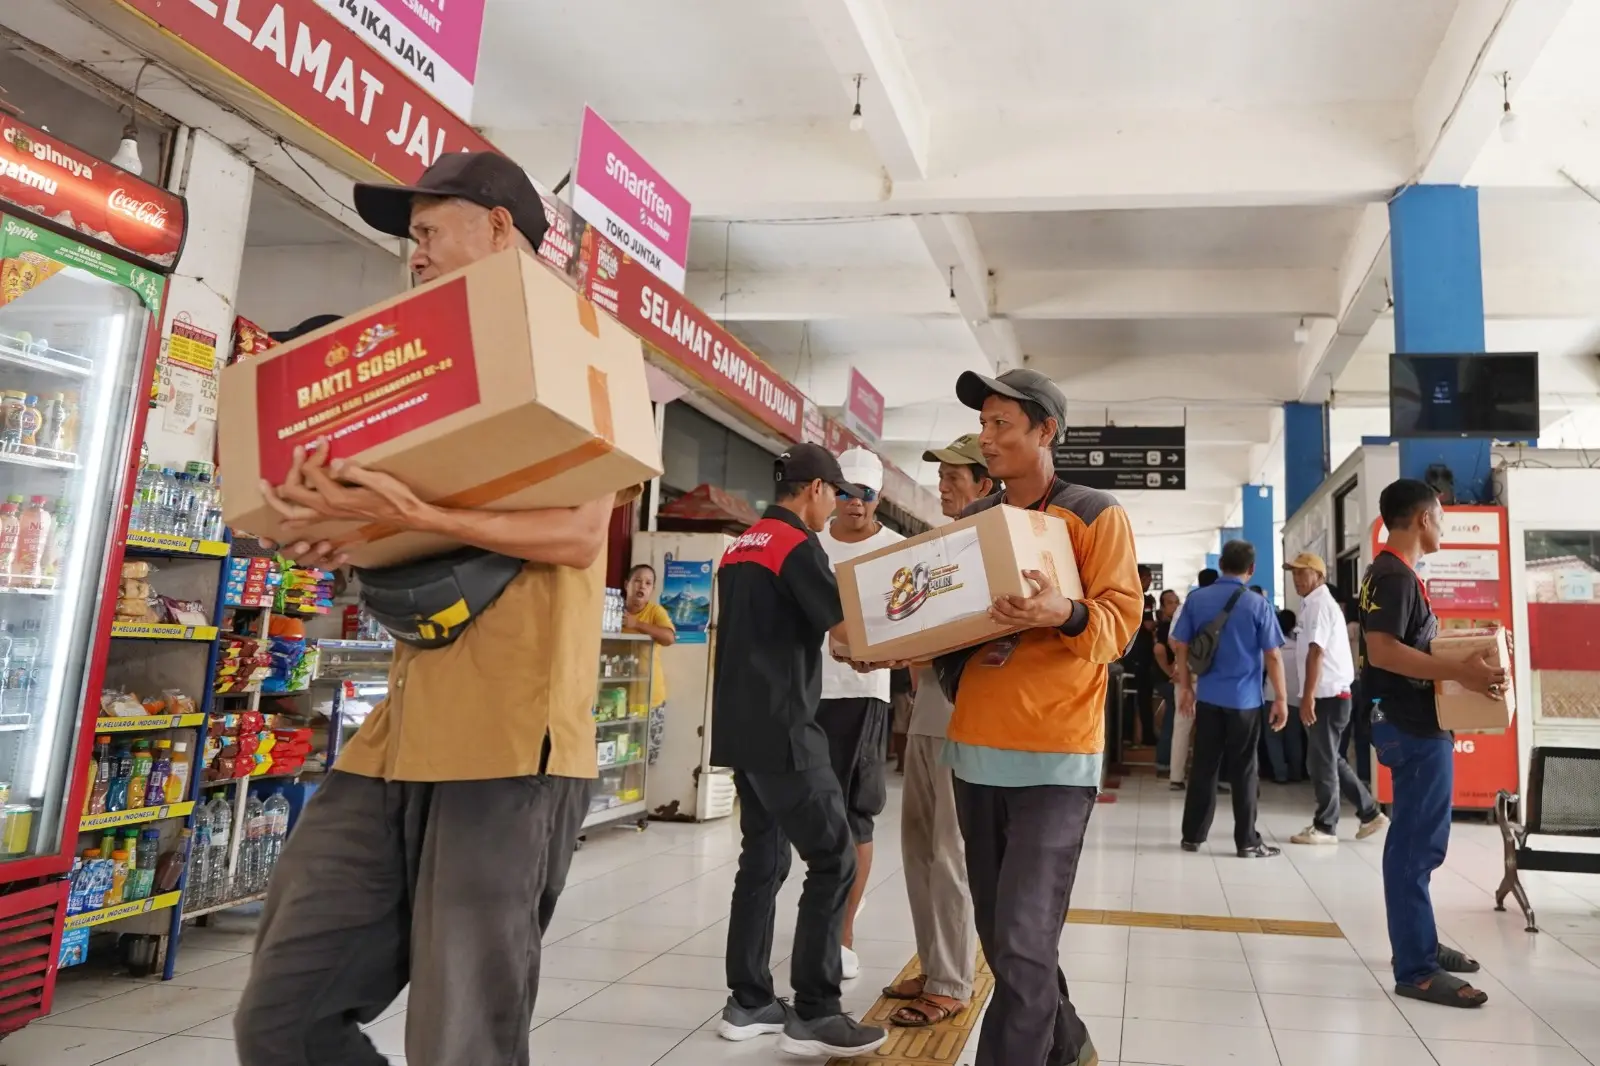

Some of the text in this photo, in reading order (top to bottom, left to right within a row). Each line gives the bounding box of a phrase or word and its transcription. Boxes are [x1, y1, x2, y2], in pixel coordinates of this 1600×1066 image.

[360, 6, 392, 48] IKA
[394, 37, 435, 83] JAYA
[187, 0, 470, 168] LAMAT JAL
[605, 151, 673, 228] smartfren
[5, 220, 39, 242] Sprite
[77, 245, 102, 261] HAUS
[605, 217, 630, 246] TOKO
[630, 239, 662, 270] JUNTAK
[639, 285, 712, 361] SELAMAT
[711, 340, 757, 397] SAMPAI
[759, 374, 797, 426] TUJUAN
[296, 338, 428, 409] BAKTI SOSIAL
[333, 420, 365, 439] UNTUK
[366, 392, 429, 425] MASYARAKAT
[277, 419, 308, 440] DALAM
[157, 538, 187, 547] INDONESIA
[151, 627, 182, 635] INDONESIA
[1453, 740, 1476, 754] NG
[123, 811, 155, 821] INDONESIA
[106, 904, 140, 917] INDONESIA
